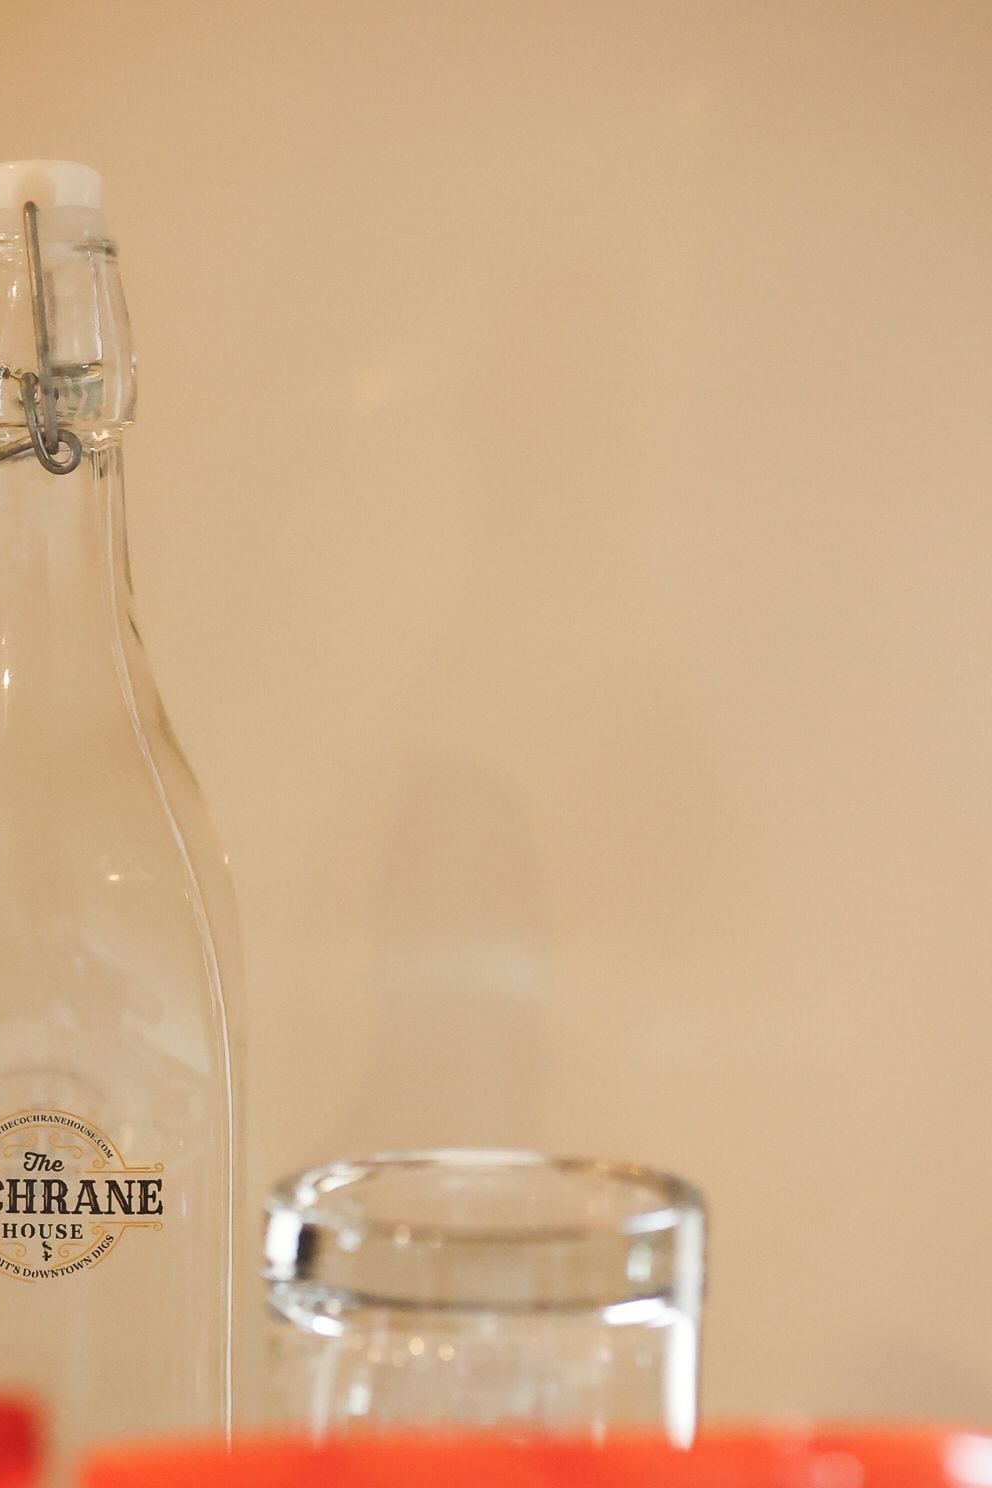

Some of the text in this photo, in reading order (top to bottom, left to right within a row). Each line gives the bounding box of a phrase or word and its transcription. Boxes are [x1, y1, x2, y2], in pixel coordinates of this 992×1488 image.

[23, 1151, 65, 1172] The
[1, 1223, 84, 1240] HOUSE
[23, 1255, 93, 1279] DOWNTOWN
[92, 1234, 115, 1260] DIGS
